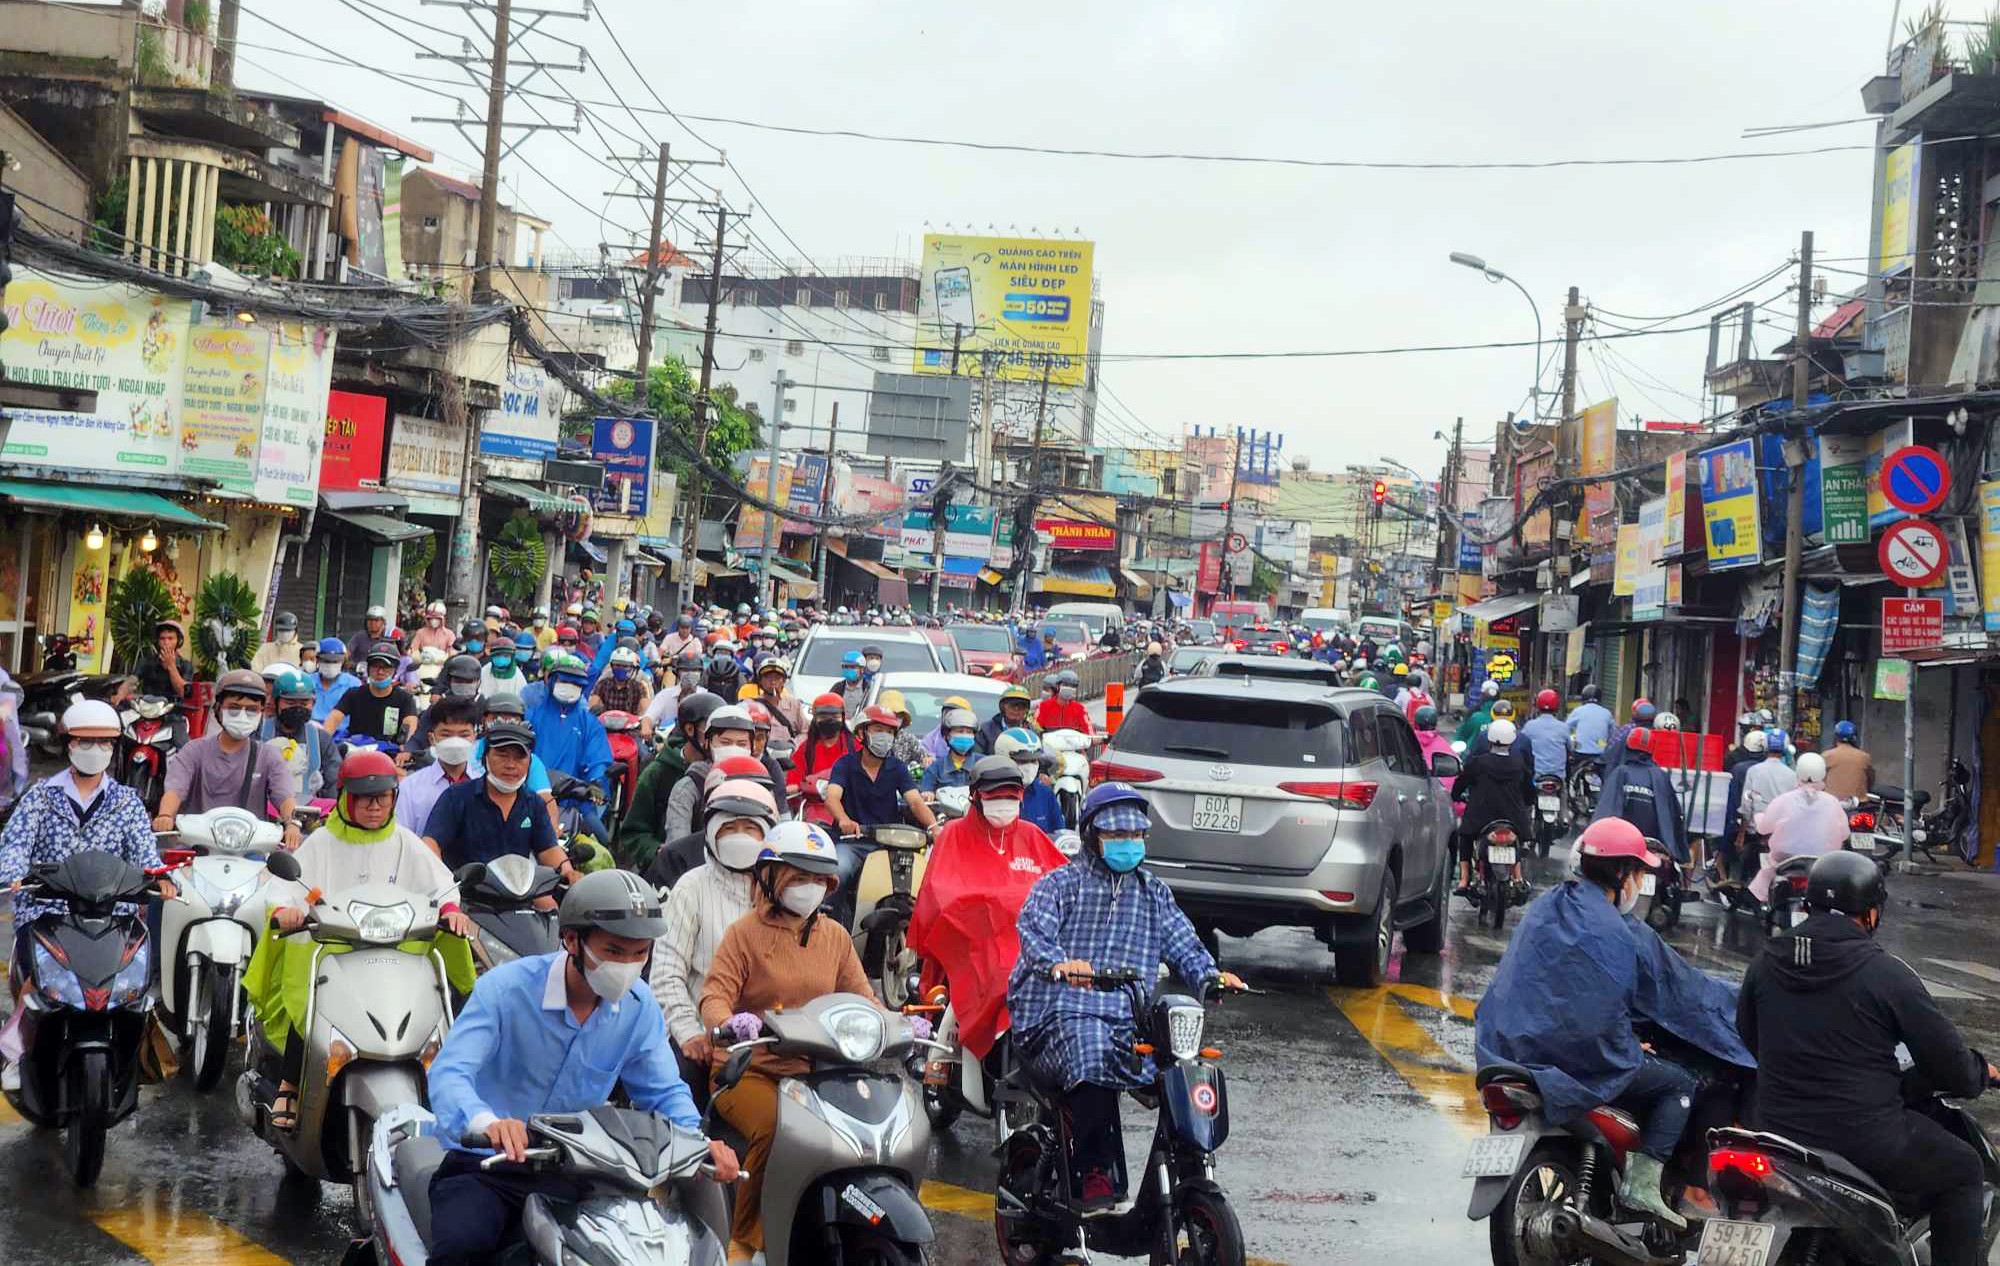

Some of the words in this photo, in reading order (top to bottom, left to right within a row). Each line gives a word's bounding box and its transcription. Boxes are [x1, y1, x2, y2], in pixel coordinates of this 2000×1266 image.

[998, 246, 1034, 257] QUẢNG
[1035, 247, 1056, 258] CÁO
[1057, 249, 1082, 260] TRÊN
[999, 260, 1026, 271] MÀN
[1028, 261, 1057, 273] HÌNH
[1059, 264, 1078, 274] LED
[1009, 275, 1037, 287] SIÊU
[1041, 278, 1065, 291] ĐẸP
[12, 366, 30, 382] HOA
[1825, 479, 1841, 491] AN
[1205, 796, 1230, 813] 60A
[1194, 813, 1239, 830] 372.26
